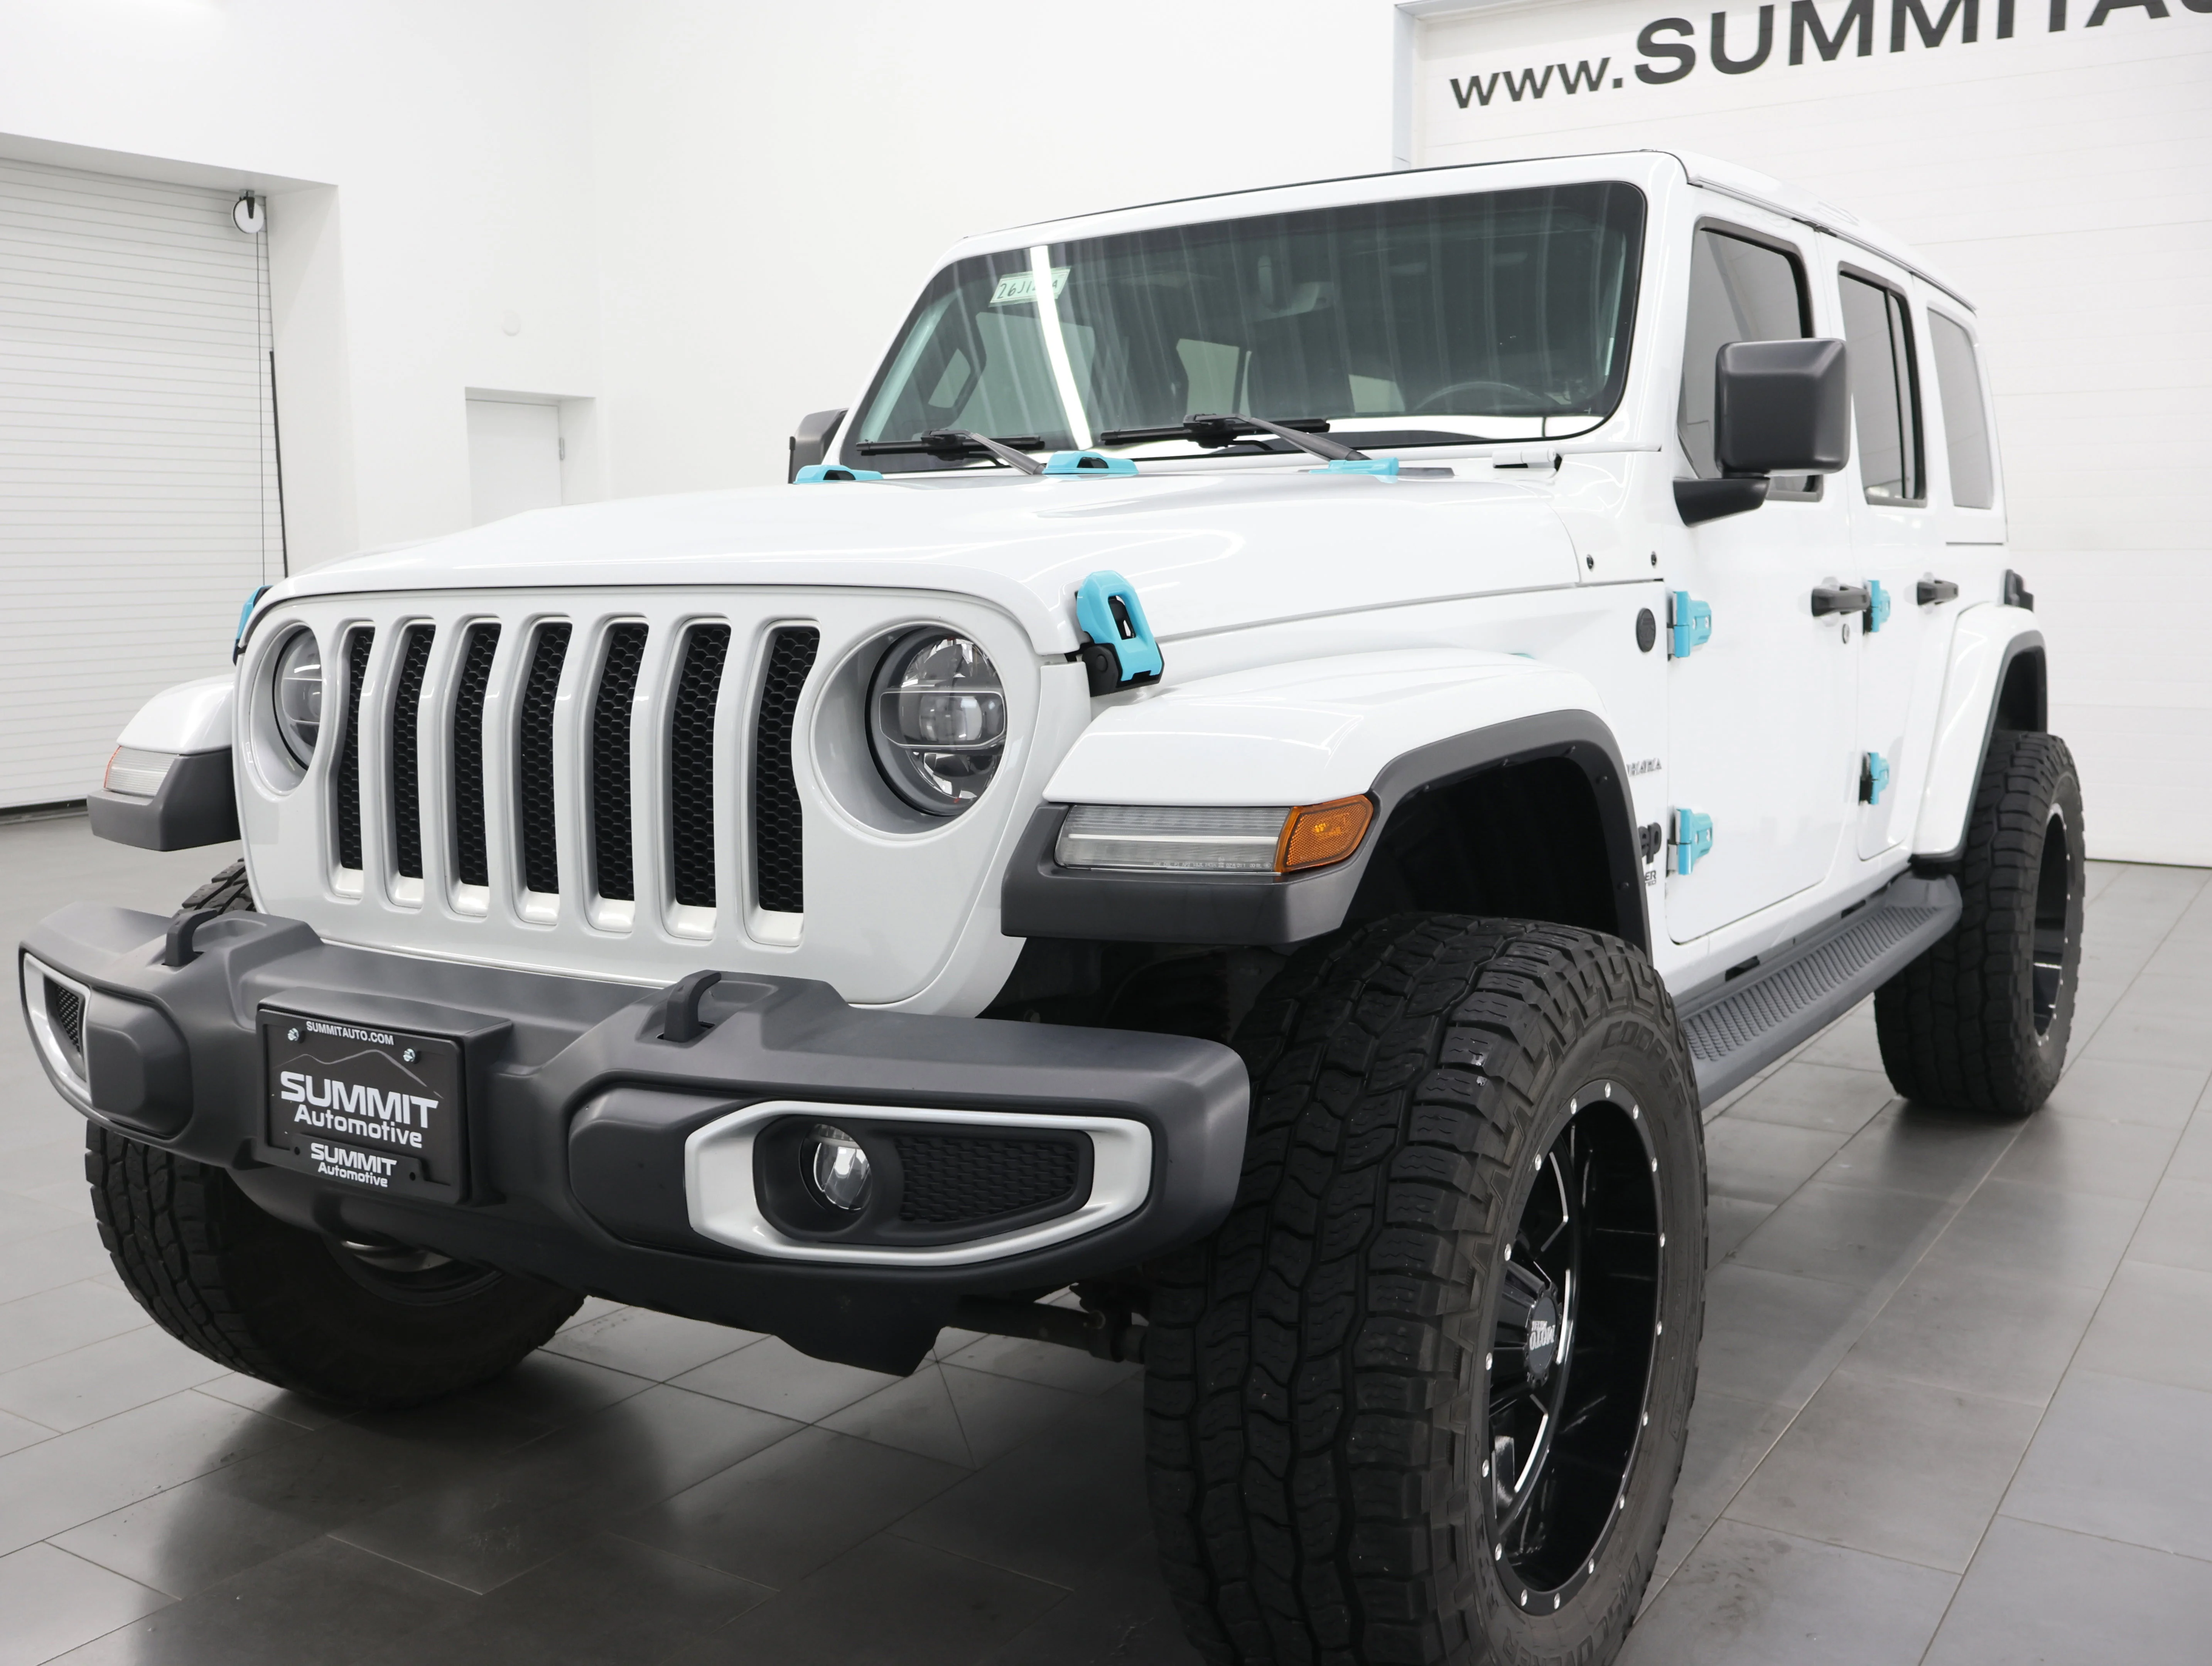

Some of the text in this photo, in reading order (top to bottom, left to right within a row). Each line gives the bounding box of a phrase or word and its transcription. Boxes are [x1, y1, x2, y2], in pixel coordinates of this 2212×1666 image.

[1449, 0, 2212, 109] www.SUMMI
[1626, 757, 1662, 777] HARA
[306, 1021, 394, 1045] SUMMITAUTO.COM
[1601, 1020, 1687, 1120] COOPER
[280, 1071, 439, 1128] SUMMIT
[294, 1104, 422, 1148] Automotive
[310, 1142, 397, 1176] SUMMIT
[317, 1162, 388, 1187] Automotive
[1529, 1324, 1556, 1351] MOTO
